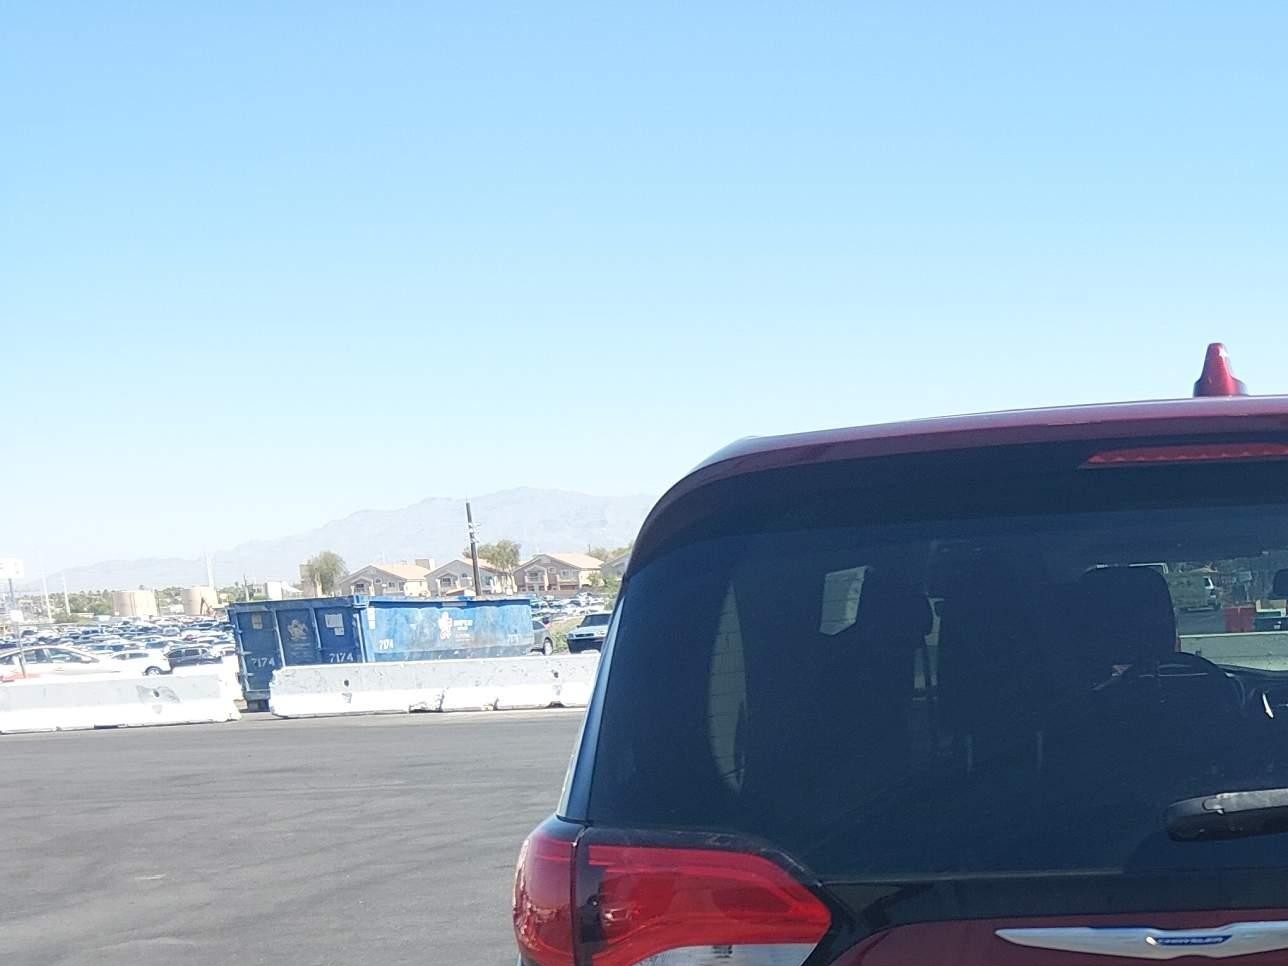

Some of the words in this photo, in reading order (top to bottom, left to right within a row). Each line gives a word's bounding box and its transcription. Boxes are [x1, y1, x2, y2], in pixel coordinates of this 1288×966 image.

[378, 639, 394, 650] 7174
[251, 656, 276, 667] 7174
[328, 652, 354, 663] 7174
